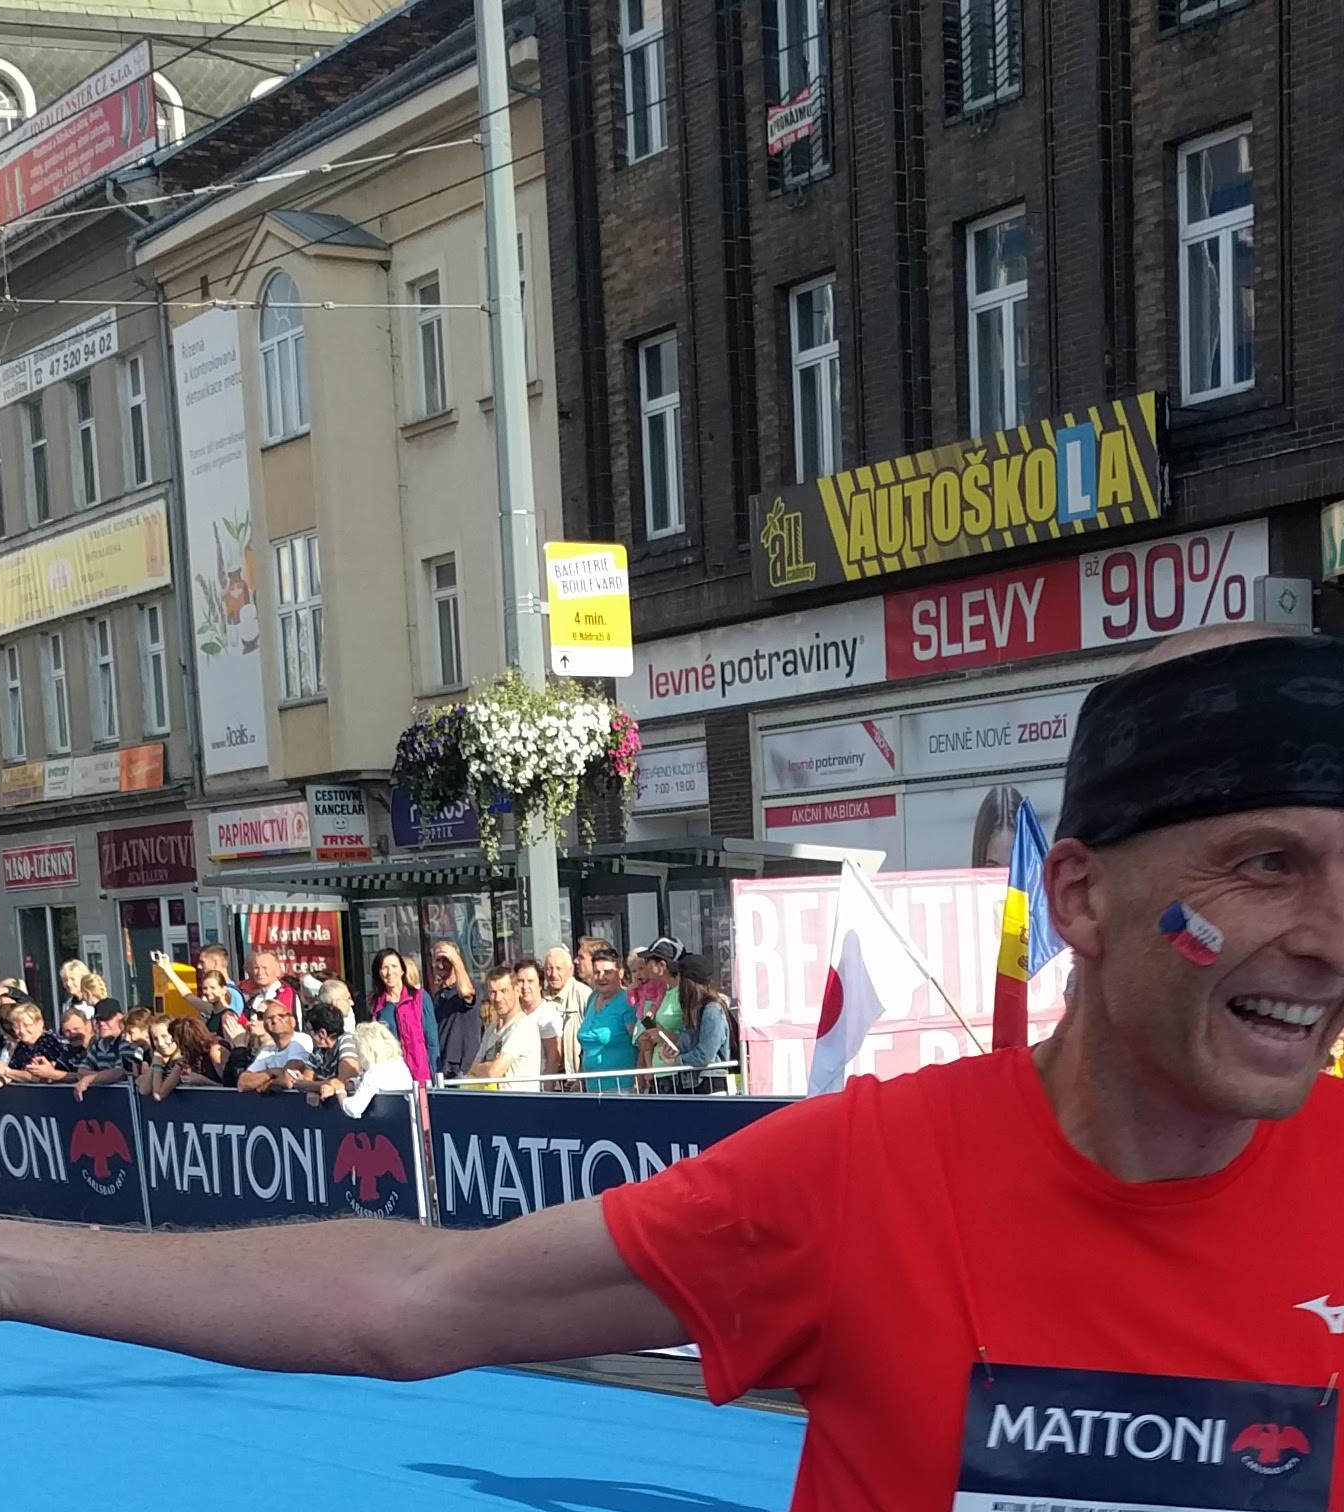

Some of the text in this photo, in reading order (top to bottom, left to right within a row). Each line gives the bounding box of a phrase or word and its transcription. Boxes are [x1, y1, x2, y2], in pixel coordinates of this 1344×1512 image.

[63, 349, 81, 372] 520
[84, 341, 95, 361] 94
[99, 333, 112, 355] 02
[846, 425, 1133, 563] AUTOŠKOLA
[912, 529, 1246, 662] SLEVY až 90%
[574, 611, 607, 626] 4 min.
[648, 632, 859, 700] levné potraviny
[975, 726, 1012, 747] NOVÉ
[1017, 713, 1067, 744] ZBOŽÍ
[816, 753, 865, 774] potraviny
[792, 800, 871, 823] AKČNÍ NABÍDKA
[218, 811, 289, 848] PAPÍRNICTVÍ
[322, 834, 365, 846] TRYSK
[268, 925, 331, 944] Kontrola
[293, 957, 327, 973] ceně
[147, 1120, 329, 1205] MATTONI
[442, 1132, 700, 1219] MATTON
[80, 1168, 116, 1196] CARLSBAD
[986, 1404, 1227, 1465] MATTONI
